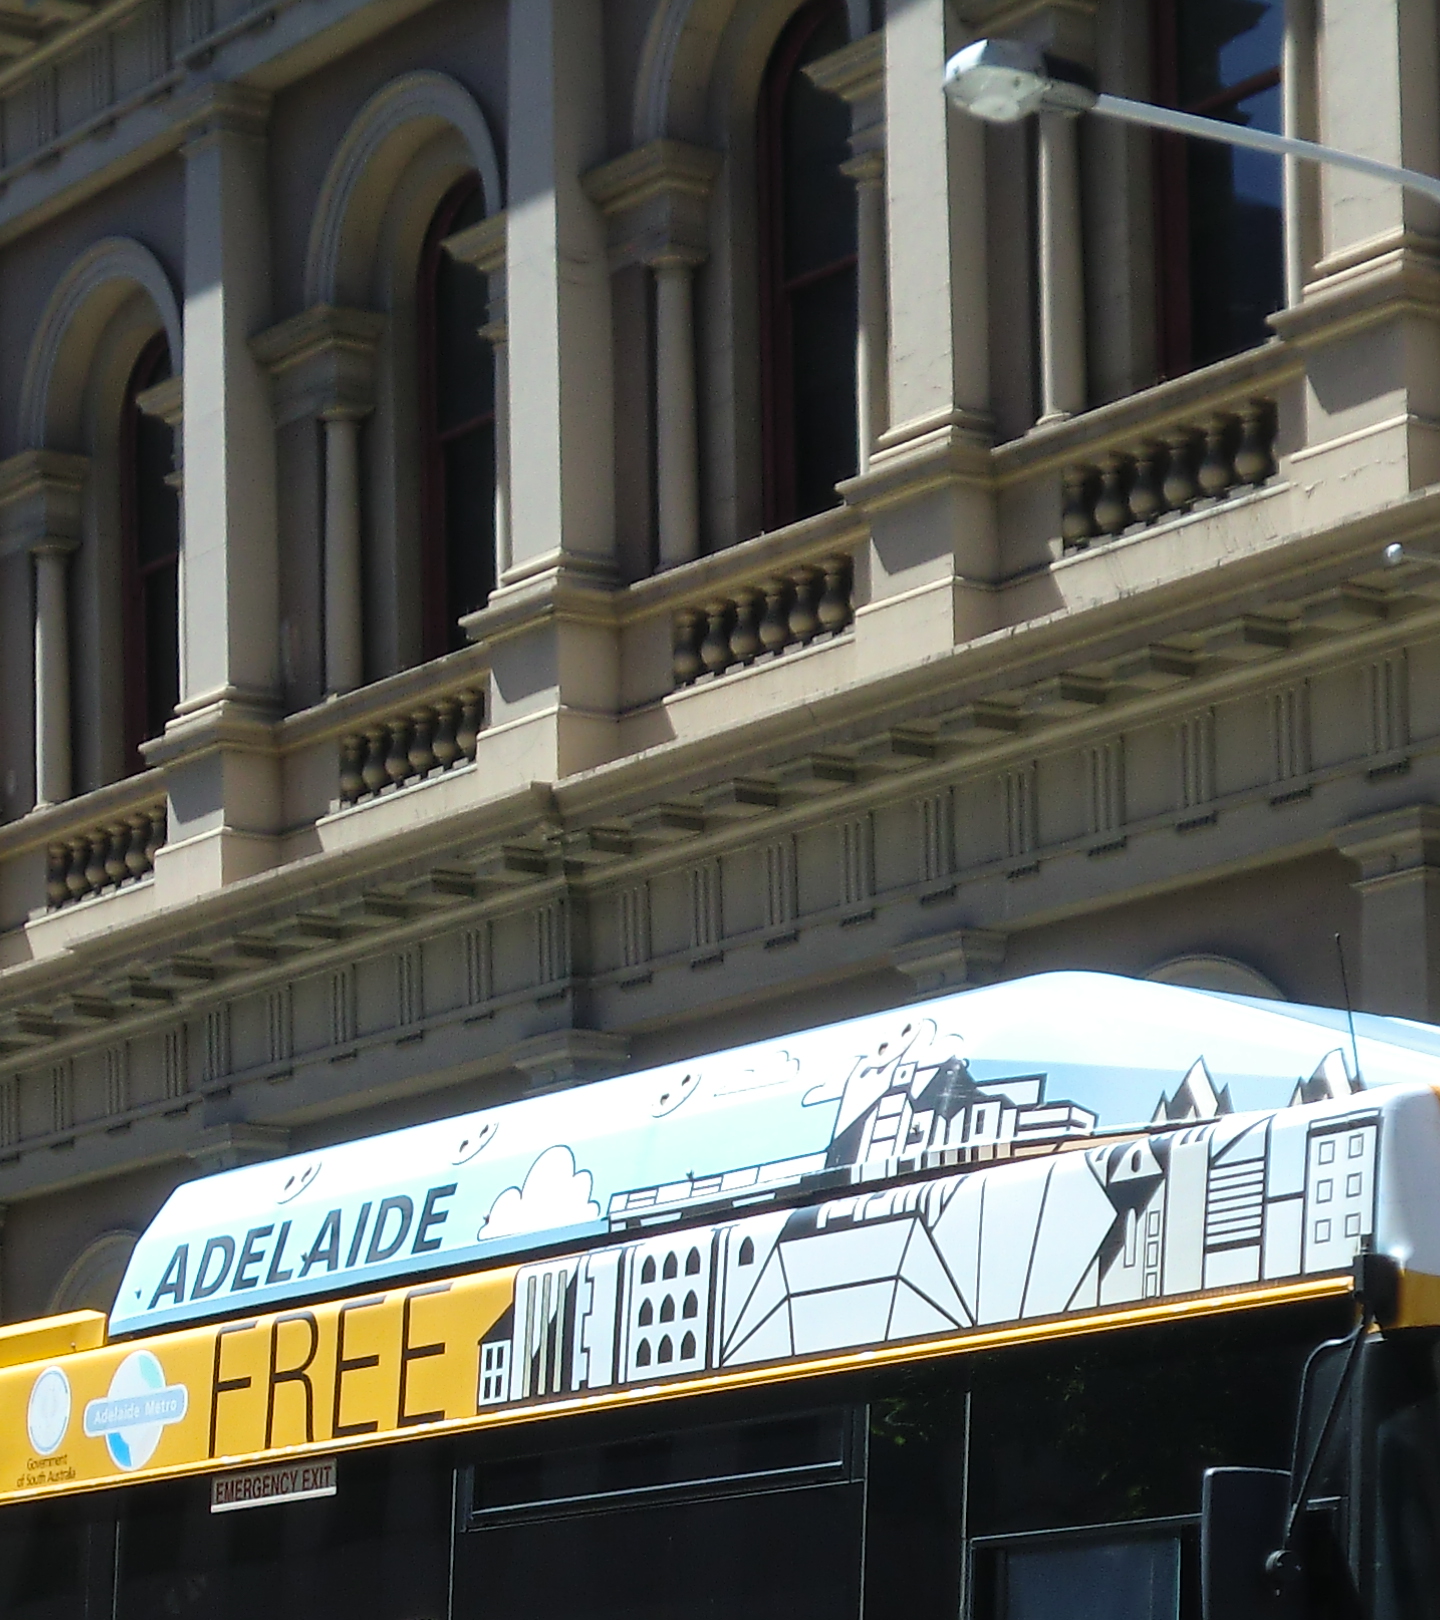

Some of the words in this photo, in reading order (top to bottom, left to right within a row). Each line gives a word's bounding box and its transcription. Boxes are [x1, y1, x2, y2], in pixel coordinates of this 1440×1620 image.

[147, 1183, 458, 1310] ADELAIDE
[93, 1404, 140, 1425] Adelaide
[144, 1399, 177, 1417] Metro
[209, 1282, 455, 1459] FREE
[215, 1469, 298, 1504] EMERGENCY
[302, 1465, 332, 1491] EXIT
